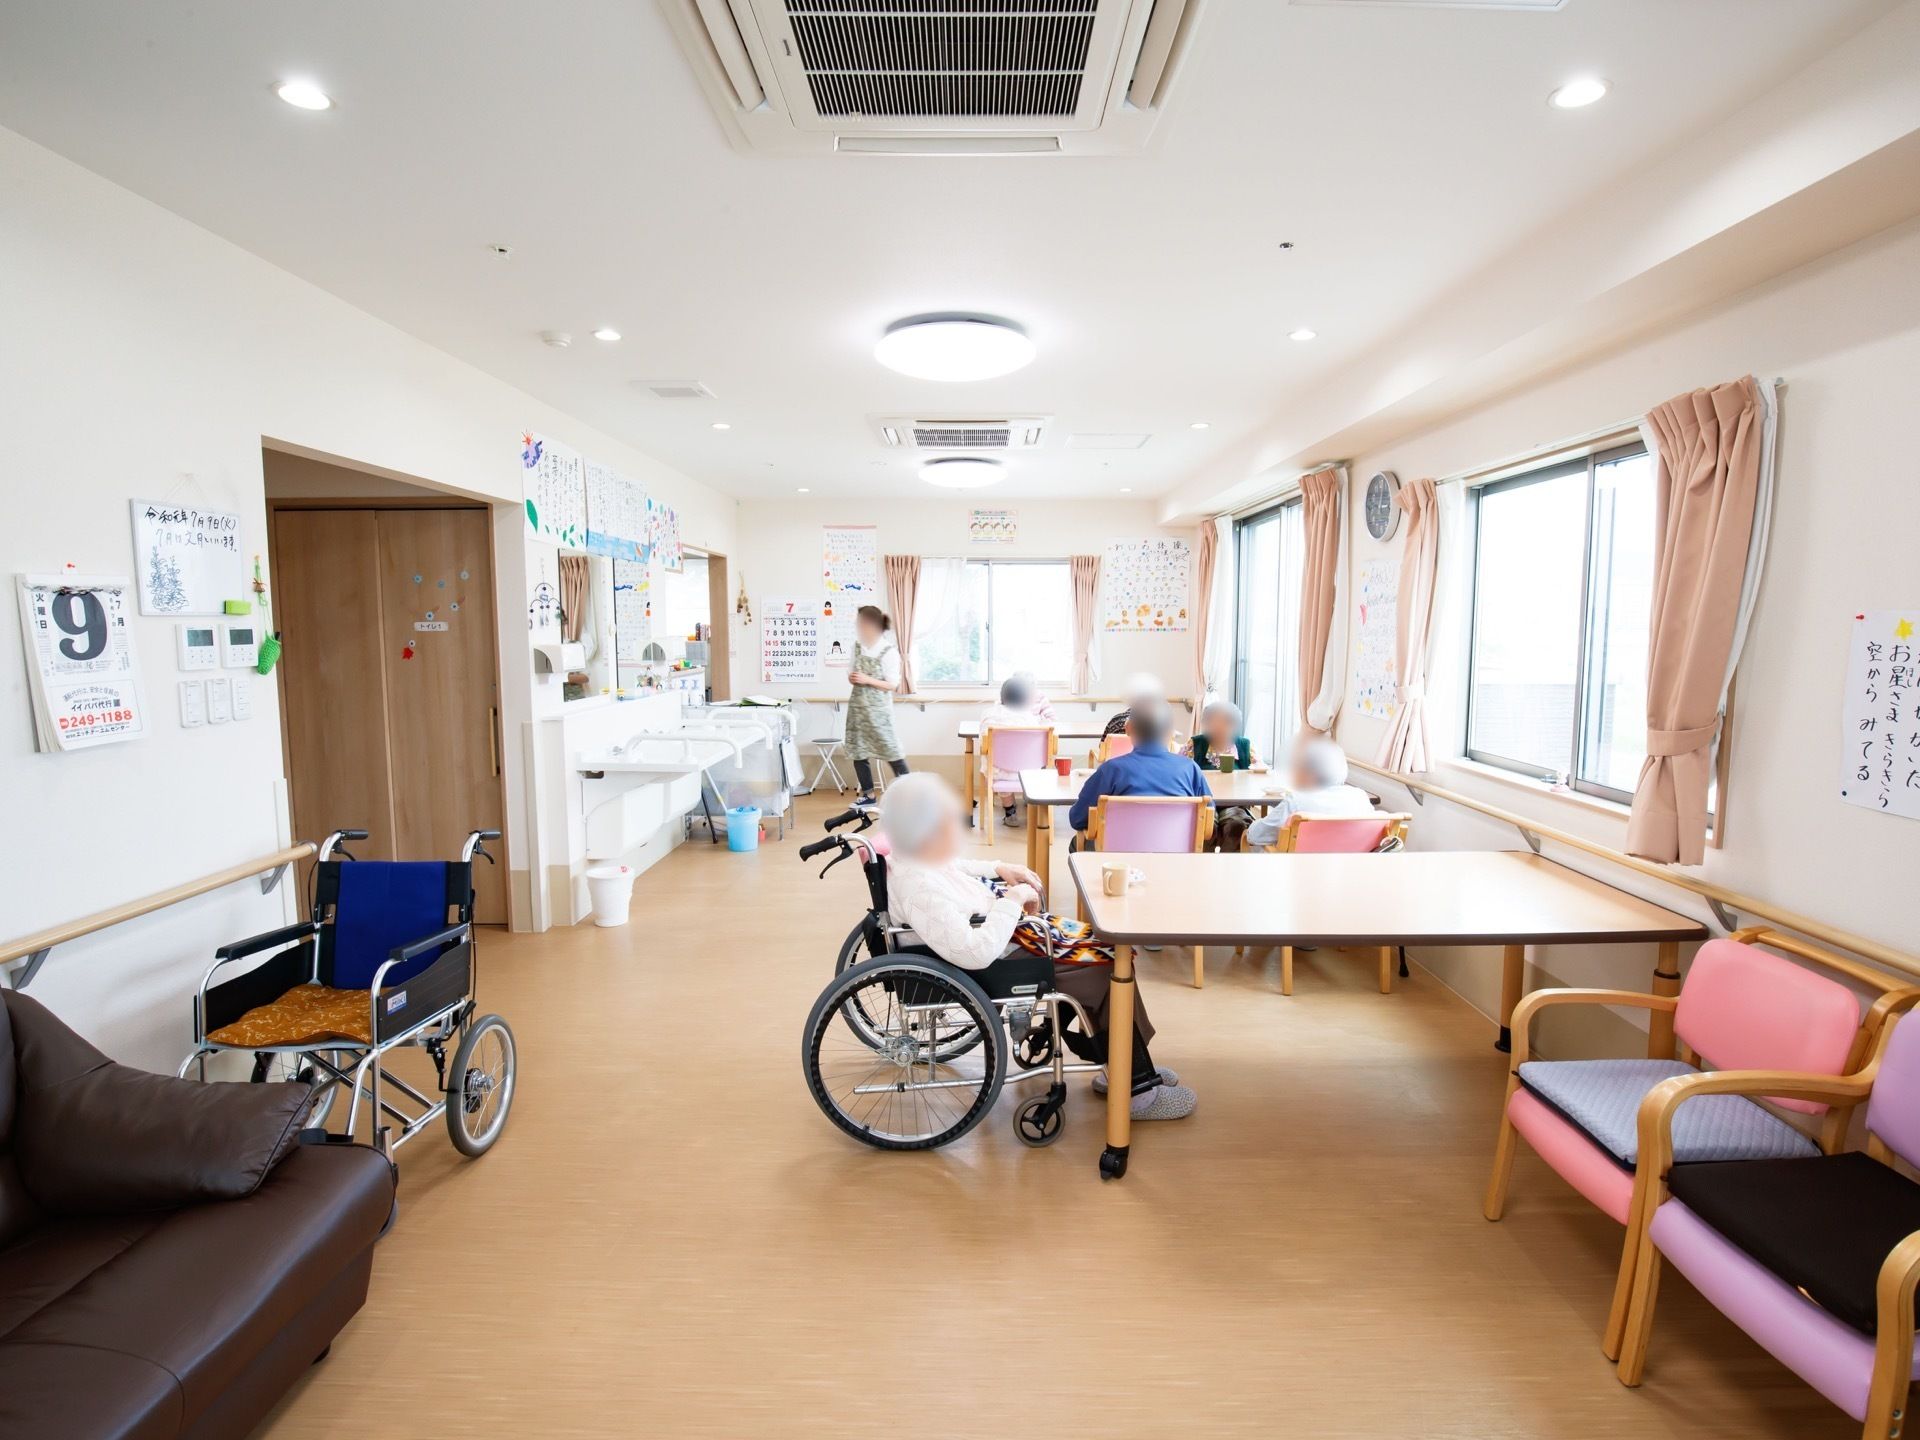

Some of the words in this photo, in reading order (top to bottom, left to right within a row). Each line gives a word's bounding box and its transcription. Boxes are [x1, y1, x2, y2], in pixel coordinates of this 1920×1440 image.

[52, 591, 107, 660] 9
[786, 603, 794, 613] 7
[1866, 641, 1882, 703] 空から
[1886, 645, 1910, 723] お星さま
[70, 710, 132, 728] 249-1188
[1857, 717, 1878, 781] みてる
